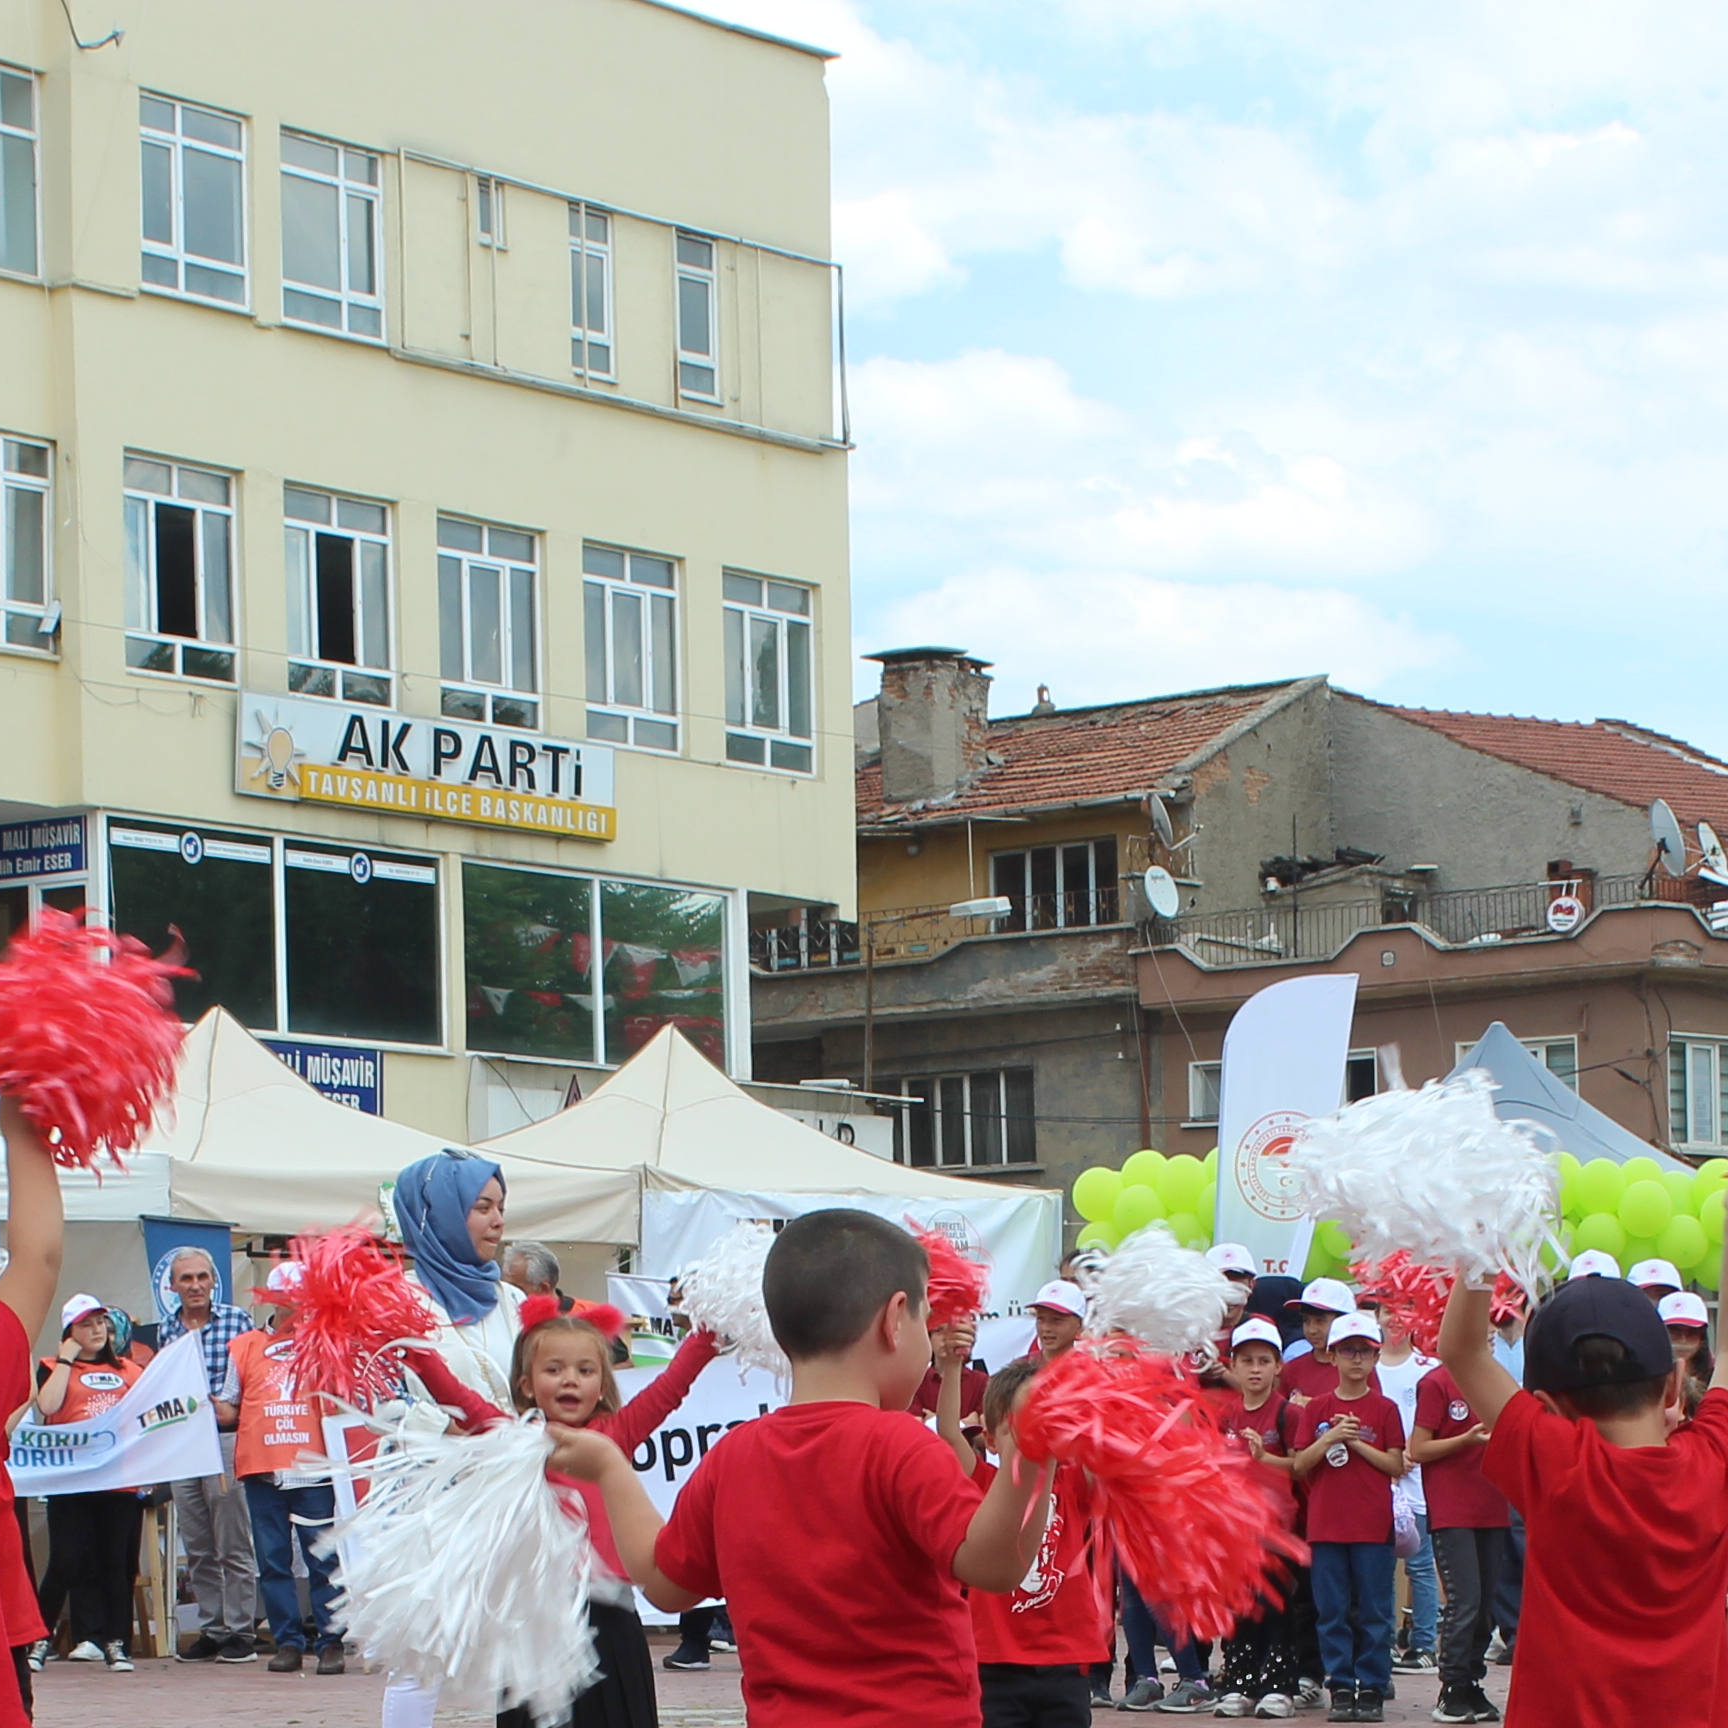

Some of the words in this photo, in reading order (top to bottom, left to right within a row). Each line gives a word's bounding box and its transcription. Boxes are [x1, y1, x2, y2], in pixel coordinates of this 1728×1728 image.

[336, 713, 413, 776] AK
[307, 770, 417, 808] TAVŞANLI
[479, 795, 607, 834] BAŞKANLIĞI
[2, 824, 29, 851] MALİ
[32, 820, 81, 850] MÜŞAVİR
[15, 856, 41, 874] Emir
[43, 852, 72, 871] ESER
[307, 1052, 374, 1089] MÜŞAVİR
[136, 1396, 186, 1428] TEMA
[263, 1403, 308, 1417] TÜRKİYE
[275, 1416, 297, 1432] ÇÖL
[20, 1430, 90, 1449] KORU
[264, 1433, 309, 1446] OLMASIN
